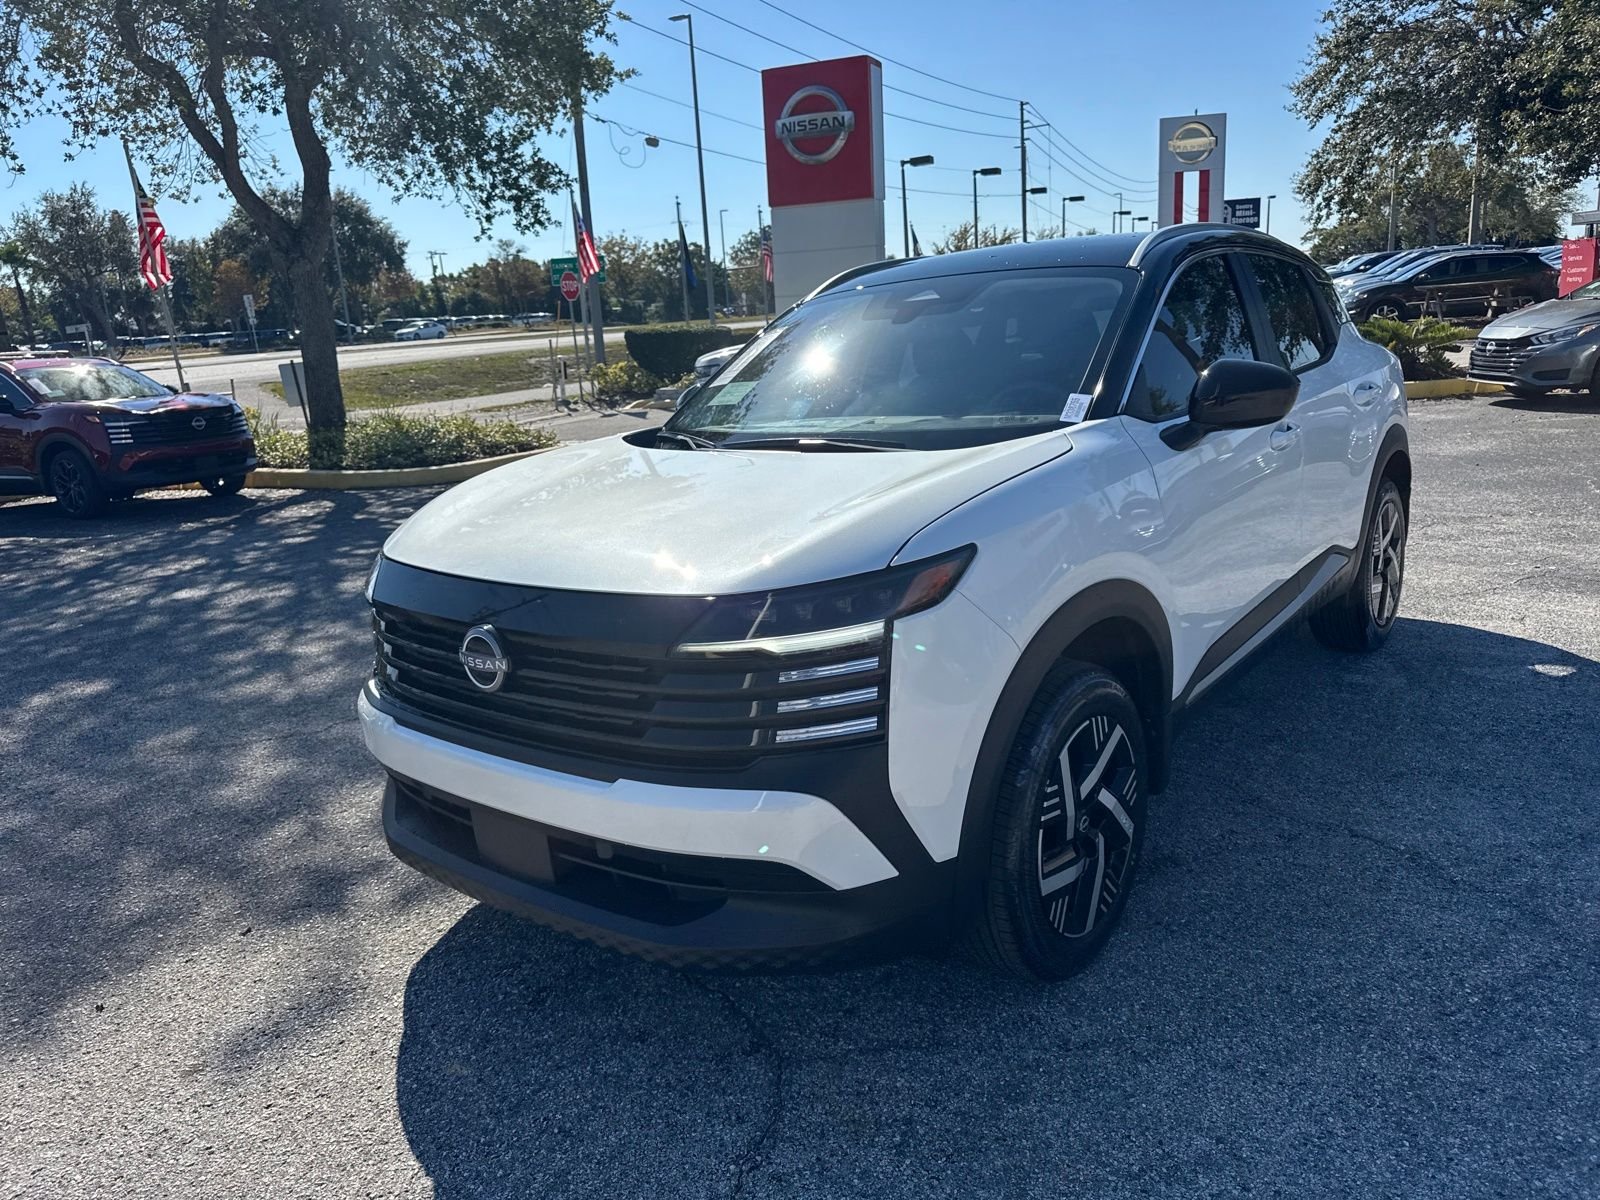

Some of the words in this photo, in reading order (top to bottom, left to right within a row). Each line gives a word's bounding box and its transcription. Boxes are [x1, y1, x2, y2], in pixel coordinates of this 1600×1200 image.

[781, 116, 845, 134] NISSAN
[1231, 216, 1258, 224] Storage
[562, 281, 578, 291] STOP
[460, 652, 506, 669] NISSAN
